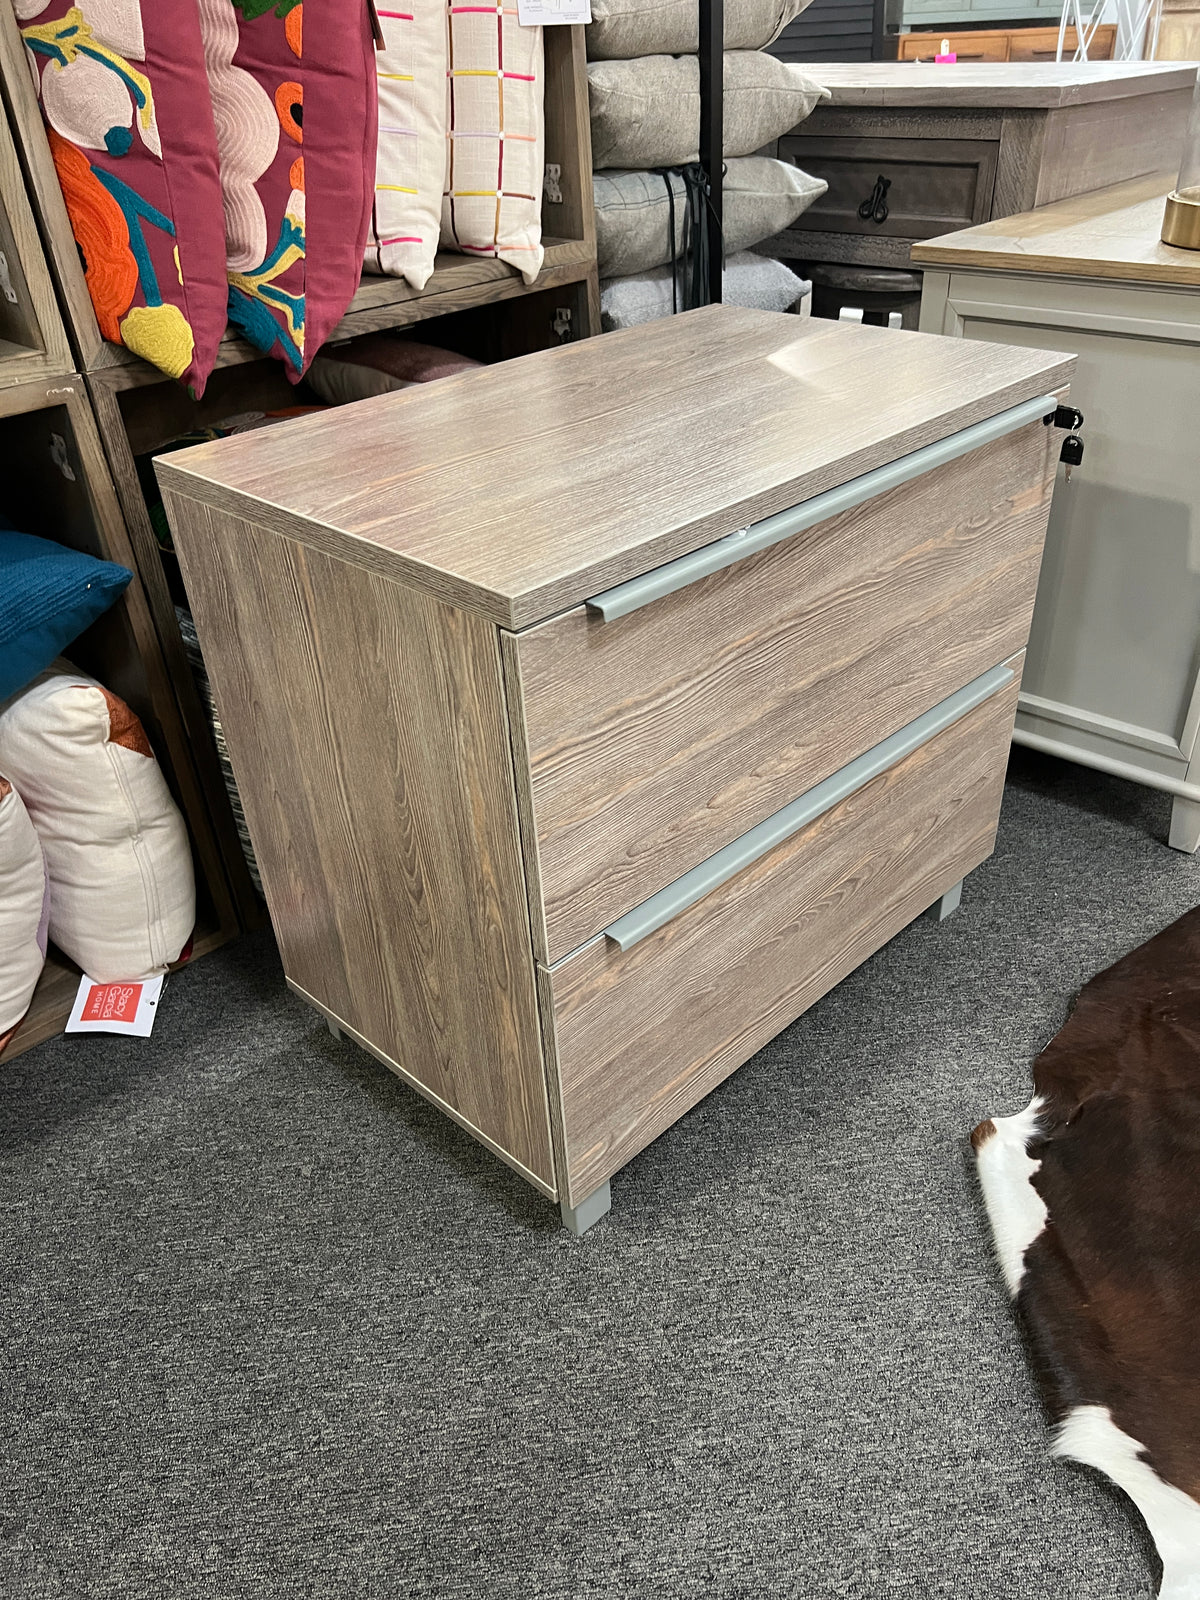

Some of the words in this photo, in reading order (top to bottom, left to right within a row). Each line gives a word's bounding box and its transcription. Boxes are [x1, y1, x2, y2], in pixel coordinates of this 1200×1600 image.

[91, 991, 104, 1014] HOME
[103, 986, 122, 1018] Garcia
[114, 987, 134, 1017] Stacy
